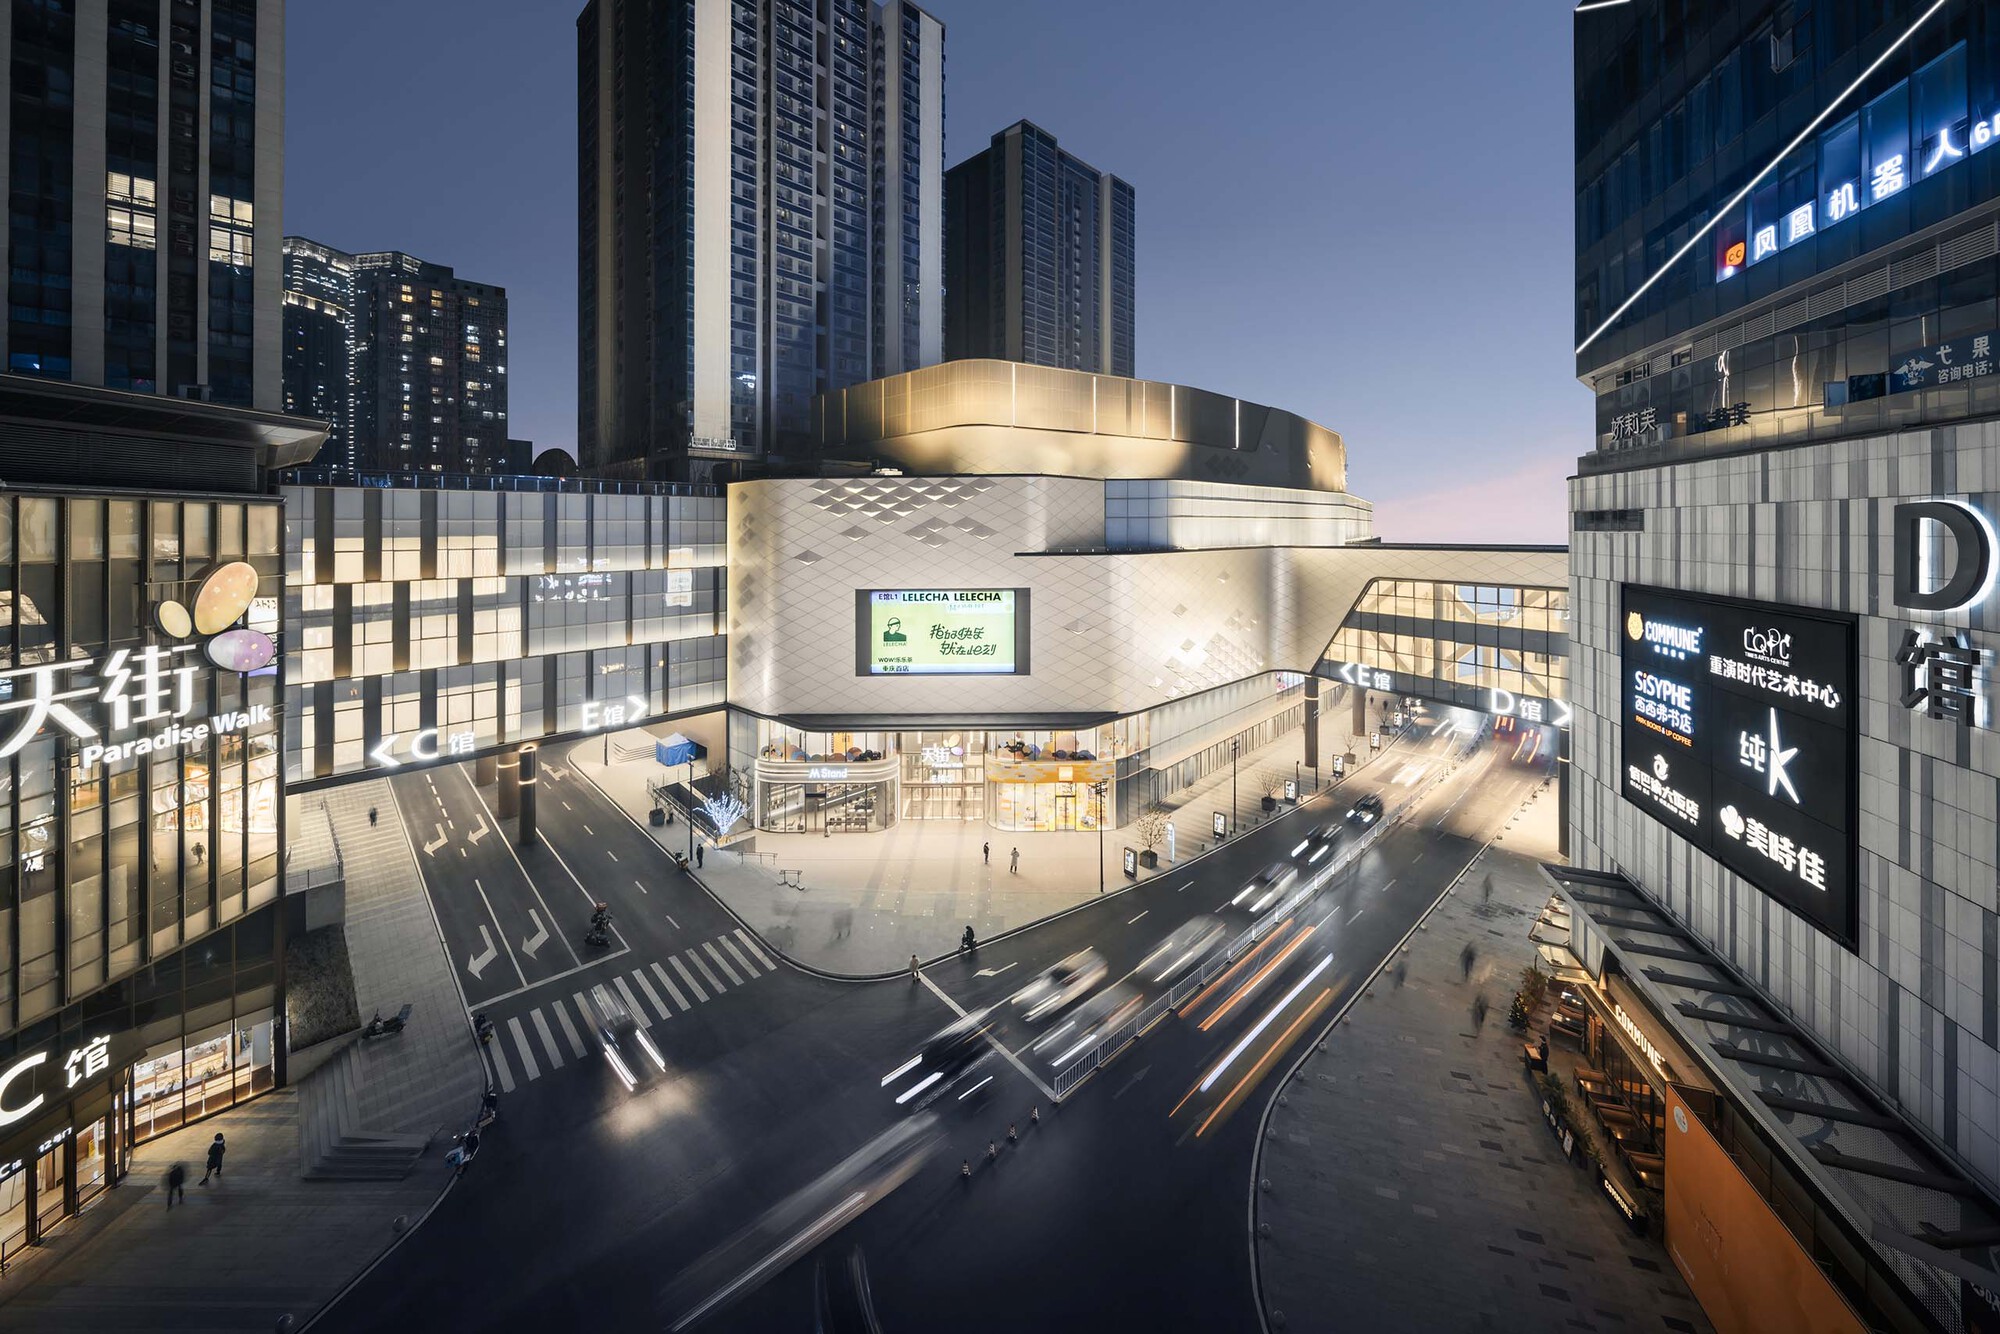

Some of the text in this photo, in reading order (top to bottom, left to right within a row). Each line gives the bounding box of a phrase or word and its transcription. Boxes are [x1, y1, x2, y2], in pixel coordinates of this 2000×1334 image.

[1755, 128, 1963, 260] 凤凰机器人
[1610, 407, 1659, 441] 娇莉芙
[903, 593, 949, 602] LELECHA
[954, 592, 1001, 602] LELECHA
[930, 623, 985, 640] 我的快乐
[940, 640, 996, 656] 就在此刻
[1357, 664, 1391, 690] E馆
[1710, 655, 1840, 709] 重演时代艺术中心
[0, 645, 199, 758] 天街
[582, 701, 625, 731] E馆
[1491, 688, 1542, 722] D馆
[1635, 695, 1692, 734] 西西弗书店
[82, 703, 272, 769] Paradise Walk
[1672, 732, 1692, 747] COFFEE
[821, 768, 848, 778] Stand
